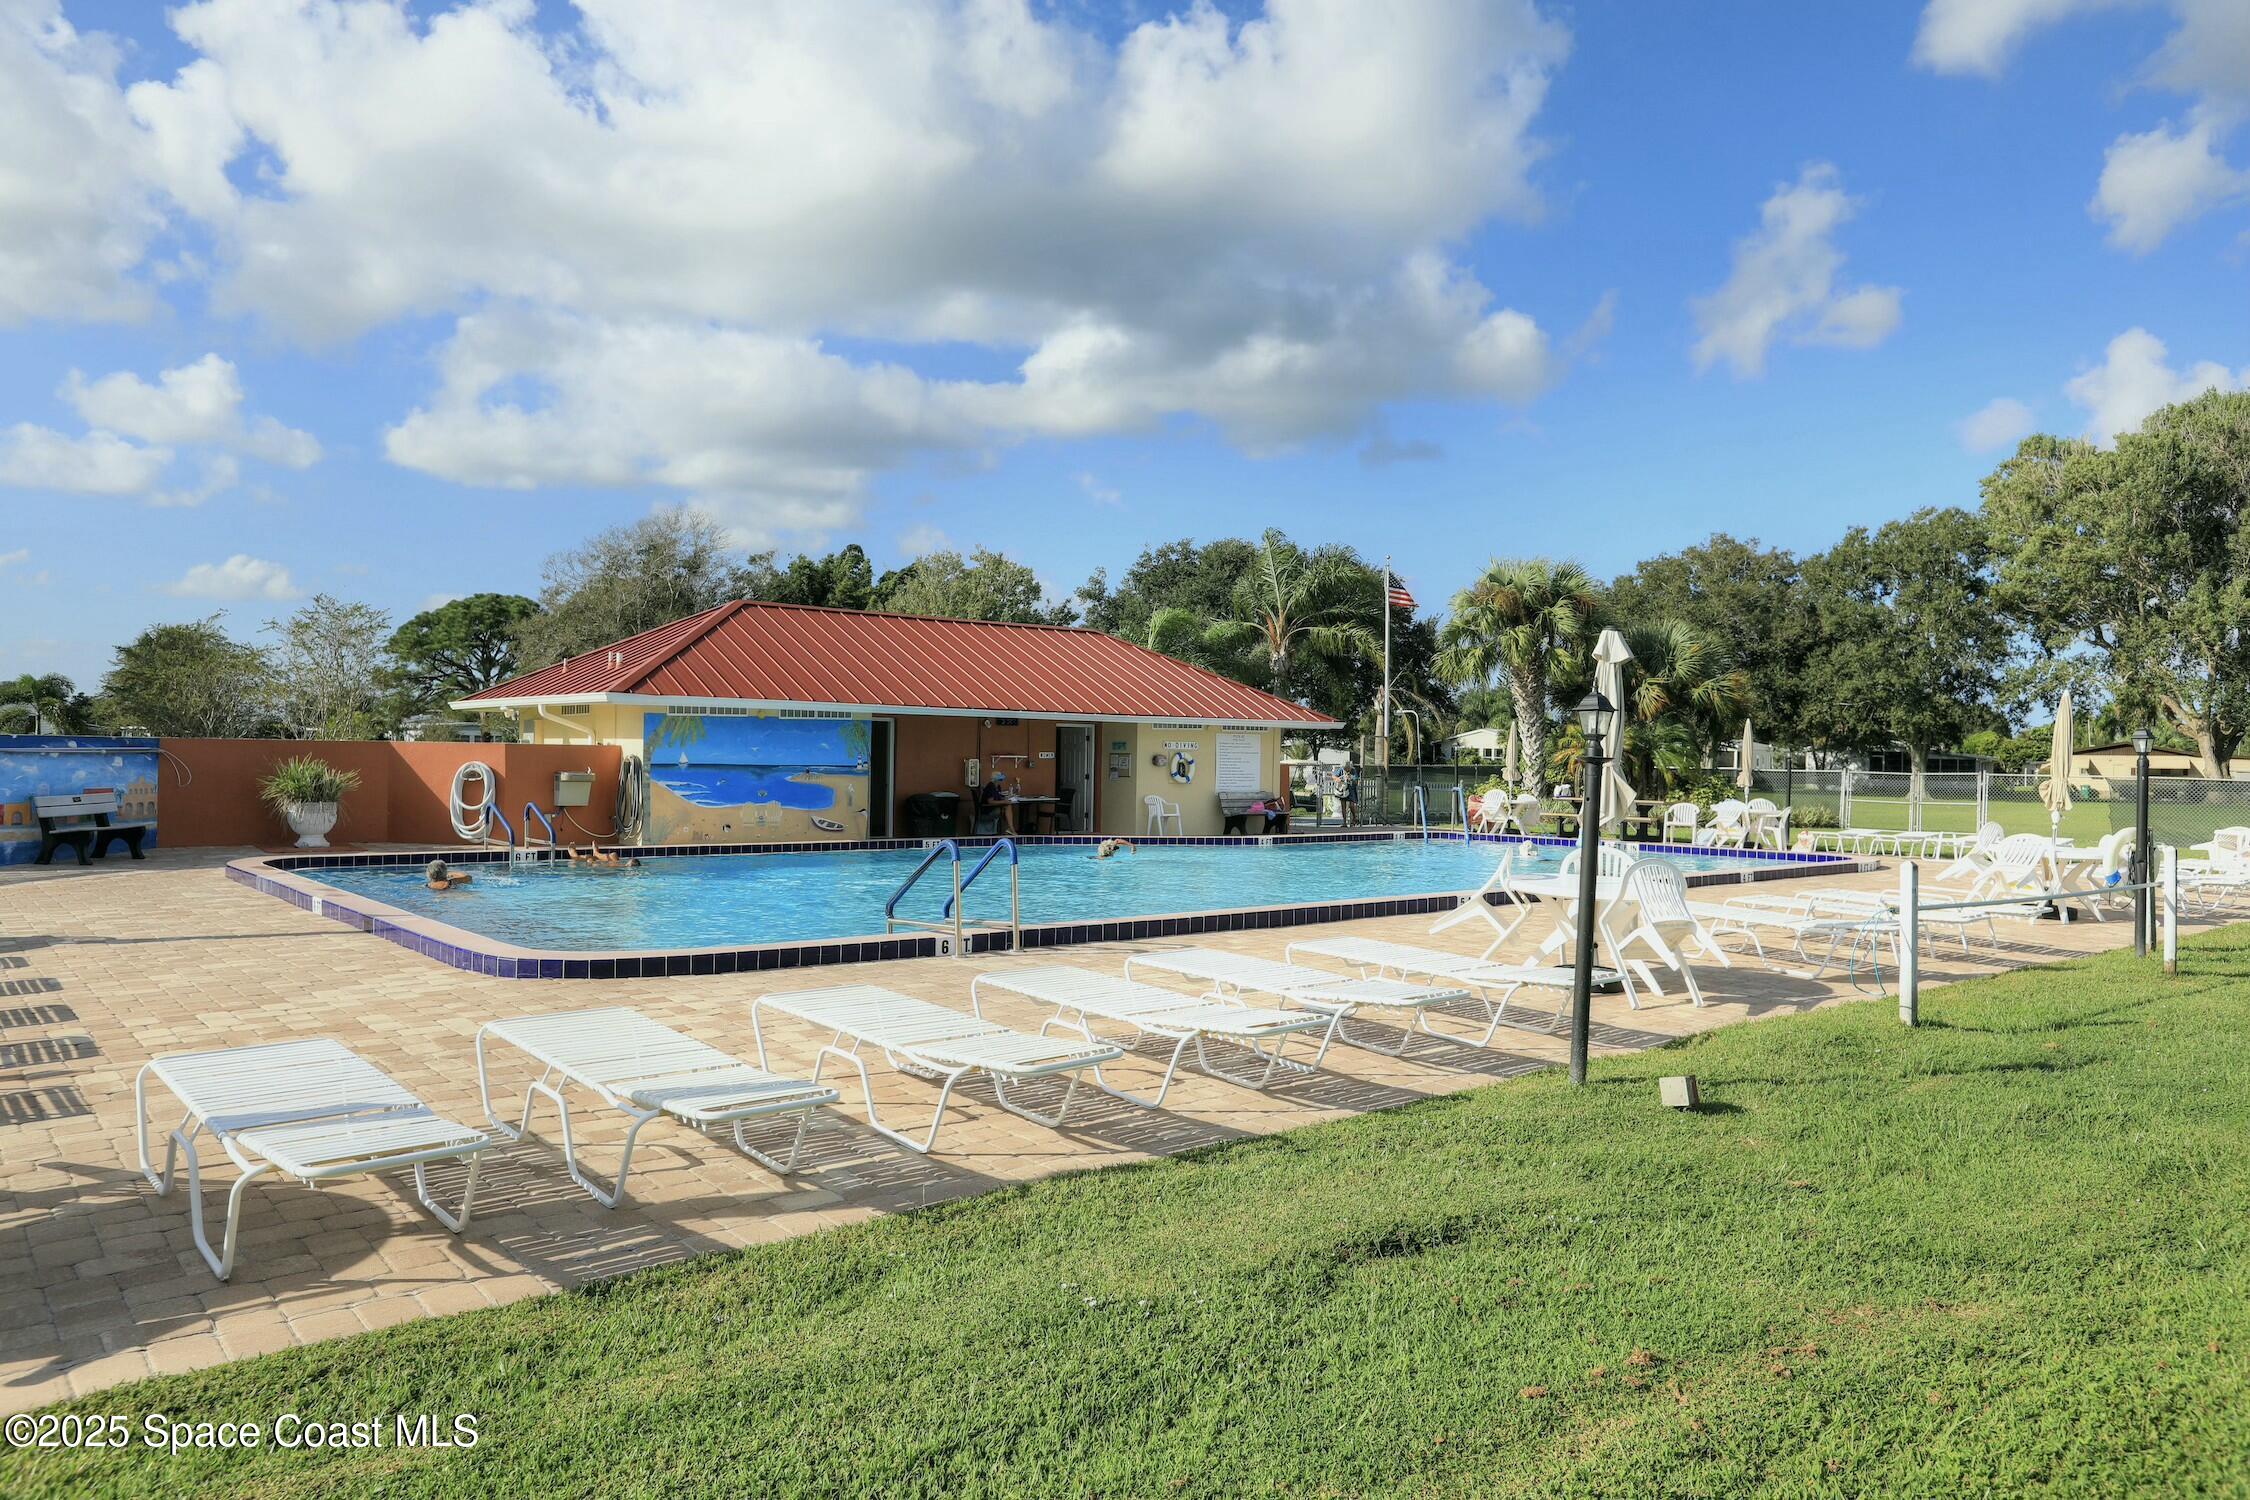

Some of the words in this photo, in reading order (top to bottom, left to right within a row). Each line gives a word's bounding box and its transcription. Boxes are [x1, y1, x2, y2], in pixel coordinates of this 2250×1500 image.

[515, 852, 521, 861] 6
[525, 852, 536, 861] FT
[942, 940, 949, 954] 6
